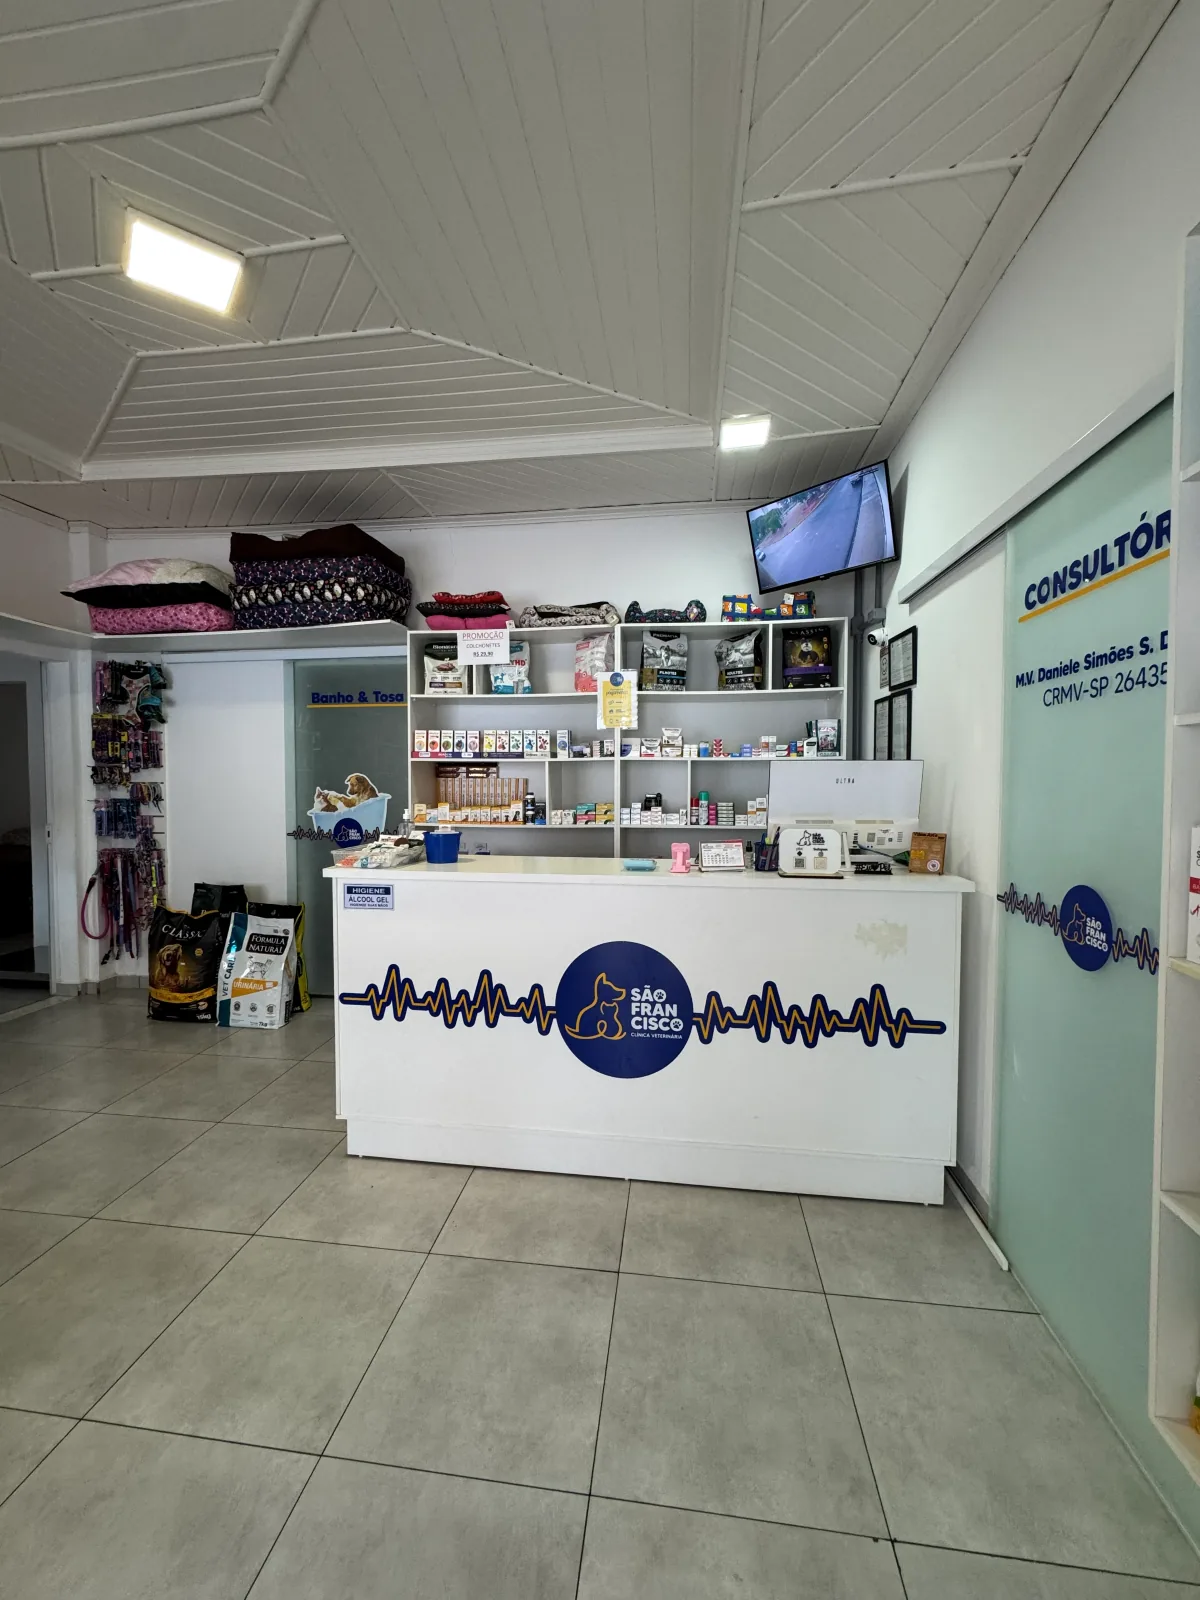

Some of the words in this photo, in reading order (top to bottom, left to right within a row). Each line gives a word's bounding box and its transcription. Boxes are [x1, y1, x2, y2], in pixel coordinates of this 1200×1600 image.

[1024, 509, 1171, 611] CONSULTÓR
[462, 631, 504, 640] PROMOÇÃO
[1016, 670, 1035, 688] M.V.
[1037, 659, 1080, 683] Daniele
[1083, 645, 1134, 671] Simões
[1138, 636, 1154, 656] S.
[311, 691, 354, 704] Banho
[357, 690, 368, 703] &
[372, 690, 405, 703] Tosa
[1043, 676, 1109, 707] CRMV-SP
[348, 895, 374, 903] ÁLCOOL
[1086, 916, 1102, 930] SÃO
[251, 934, 285, 945] FÓRMULA
[1085, 926, 1106, 942] FRAN
[1085, 935, 1108, 952] CISCO
[233, 980, 264, 991] URINÁRIA
[630, 985, 667, 1003] SÃO
[631, 1002, 678, 1017] FRAN
[630, 1016, 684, 1032] CISCO
[630, 1031, 651, 1039] CLÍNICA
[651, 1032, 683, 1040] VETERINÁRIA
